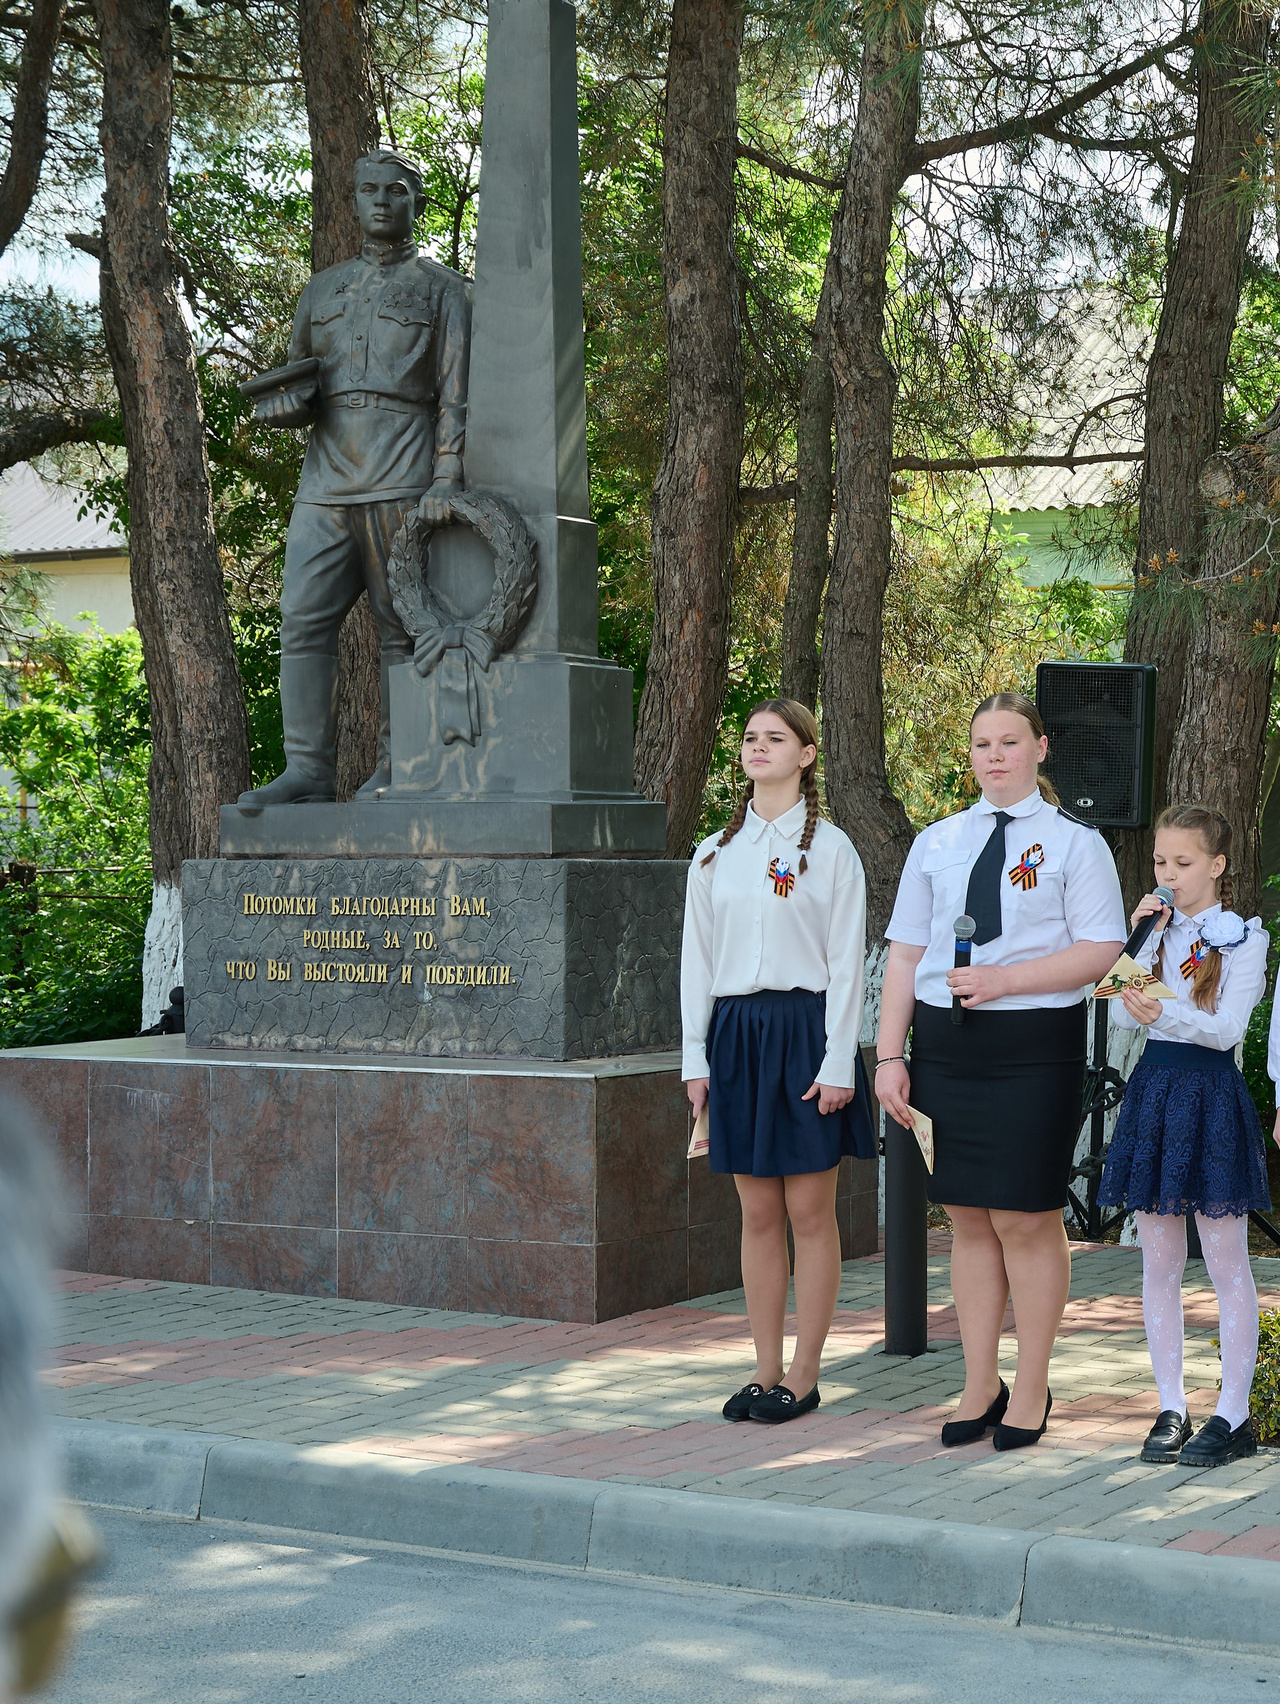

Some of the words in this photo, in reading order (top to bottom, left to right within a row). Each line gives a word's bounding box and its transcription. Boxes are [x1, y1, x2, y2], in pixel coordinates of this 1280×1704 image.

[382, 930, 401, 949] ЗА
[225, 961, 257, 980] ЧТО
[401, 965, 413, 984] И
